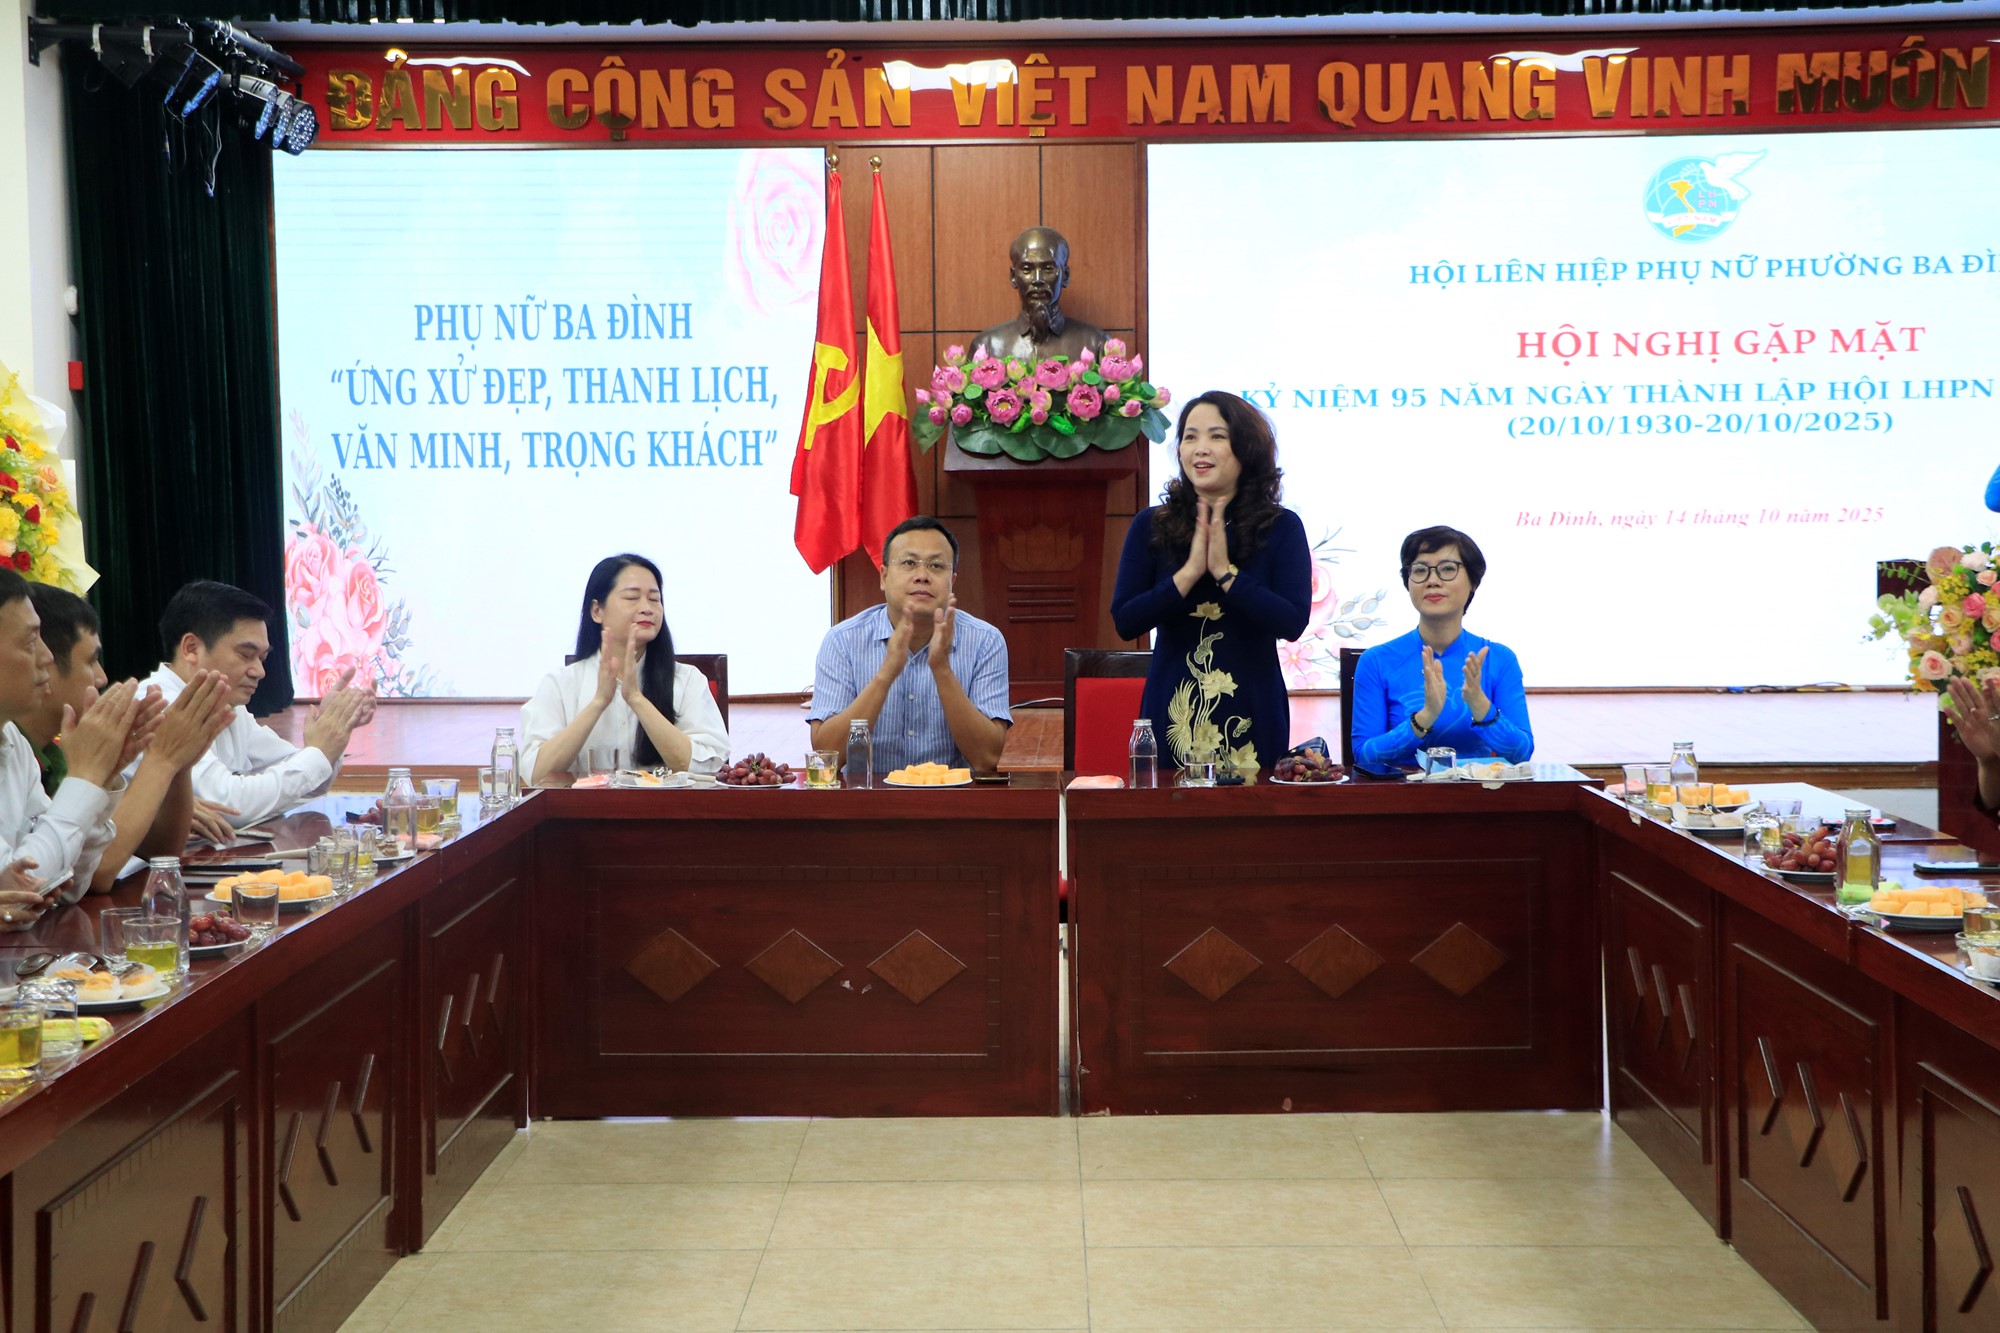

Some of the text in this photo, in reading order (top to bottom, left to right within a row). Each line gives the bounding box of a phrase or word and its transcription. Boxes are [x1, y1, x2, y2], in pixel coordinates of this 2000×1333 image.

[327, 36, 1989, 140] ĐẢNG CỘNG SẢN VIỆT NAM QUANG VINH MUÔN
[1410, 248, 2000, 289] HỘI LIÊN HIỆP PHỤ NỮ PHƯỜNG BA ĐÌ
[414, 294, 692, 351] PHỤ NỮ BA ĐÌNH
[1517, 321, 1925, 366] HỘI NGHỊ GẶP MẶT
[331, 354, 777, 414] “ỨNG XỬ ĐẸP, THANH LỊCH,
[1240, 375, 1993, 412] KỶ NIỆM 95 NĂM NGÀY THÀNH LẬP HỘI LHPN
[1508, 411, 1893, 438] (20/10/1930-20/10/2025)
[331, 421, 777, 478] VĂN MINH, TRỌNG KHÁCH”
[1516, 511, 1541, 527] Ba
[1611, 510, 1657, 529] ngày
[1666, 510, 1687, 525] 14
[1693, 508, 1749, 528] tháng
[1758, 509, 1780, 524] 10
[1786, 509, 1830, 524] năm
[1837, 507, 1883, 523] 2025
